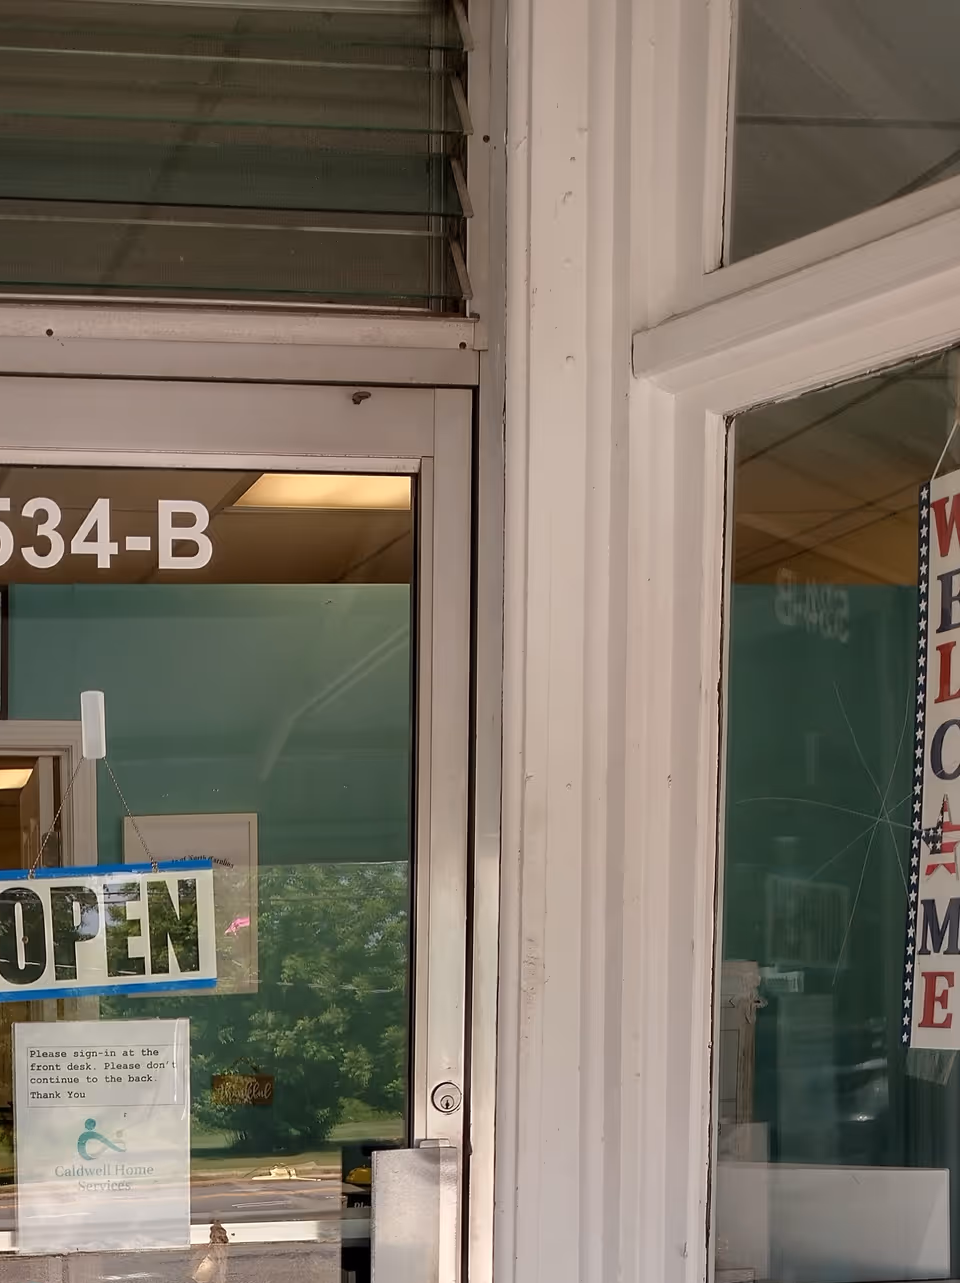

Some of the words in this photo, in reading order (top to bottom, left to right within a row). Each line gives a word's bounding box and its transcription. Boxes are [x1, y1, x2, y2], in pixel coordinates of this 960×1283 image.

[30, 1050, 67, 1058] Please
[73, 1049, 116, 1059] sign-in
[122, 1049, 135, 1057] at
[141, 1048, 159, 1057] the
[30, 1063, 61, 1071] front
[67, 1063, 97, 1071] desk.
[104, 1062, 141, 1070] Please
[146, 1061, 176, 1069] don't
[30, 1076, 80, 1084] continue
[105, 1075, 122, 1083] the
[128, 1074, 157, 1082] back.
[30, 1091, 61, 1099] Thank
[67, 1091, 86, 1099] You
[54, 1164, 110, 1177] Caldwell
[115, 1164, 154, 1176] Home
[78, 1180, 131, 1191] Services
